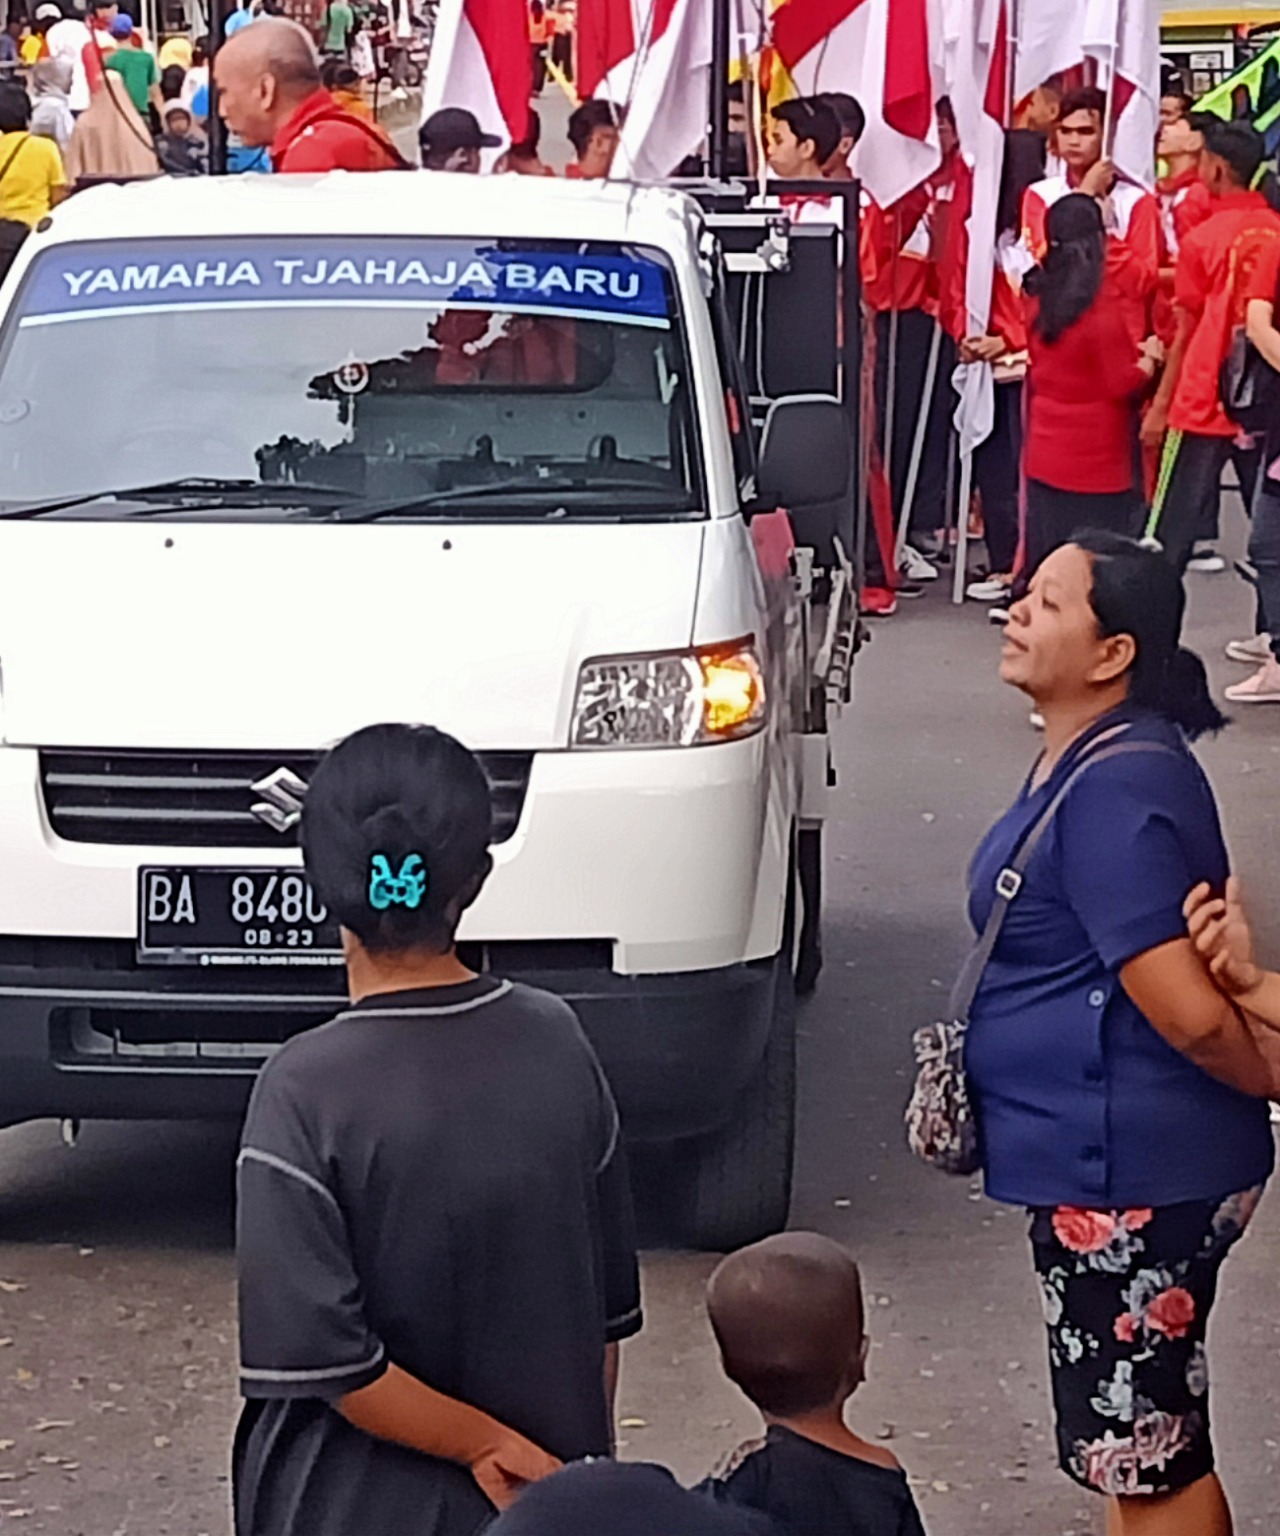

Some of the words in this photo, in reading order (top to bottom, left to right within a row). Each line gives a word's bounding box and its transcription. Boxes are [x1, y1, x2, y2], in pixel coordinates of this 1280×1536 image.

[63, 260, 261, 297] YAMAHA
[273, 259, 494, 287] TJAHAJA
[505, 262, 640, 299] BARU
[147, 873, 196, 924] BA
